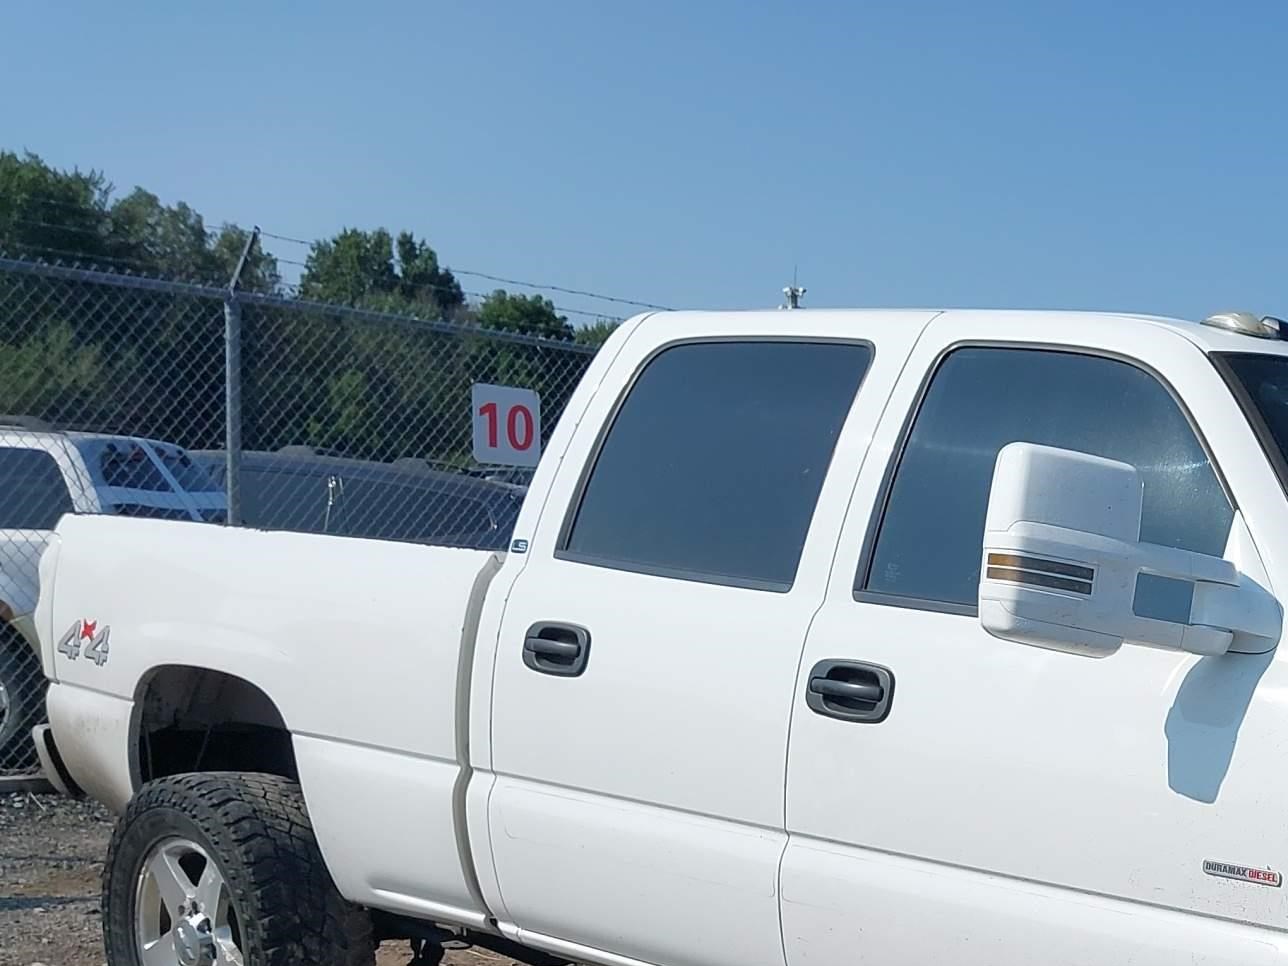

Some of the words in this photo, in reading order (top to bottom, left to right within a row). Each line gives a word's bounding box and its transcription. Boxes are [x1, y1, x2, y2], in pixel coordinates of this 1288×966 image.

[478, 402, 535, 452] 10
[511, 540, 528, 551] LS
[1205, 861, 1248, 878] DURAMAX
[1247, 868, 1278, 883] DIESEL
